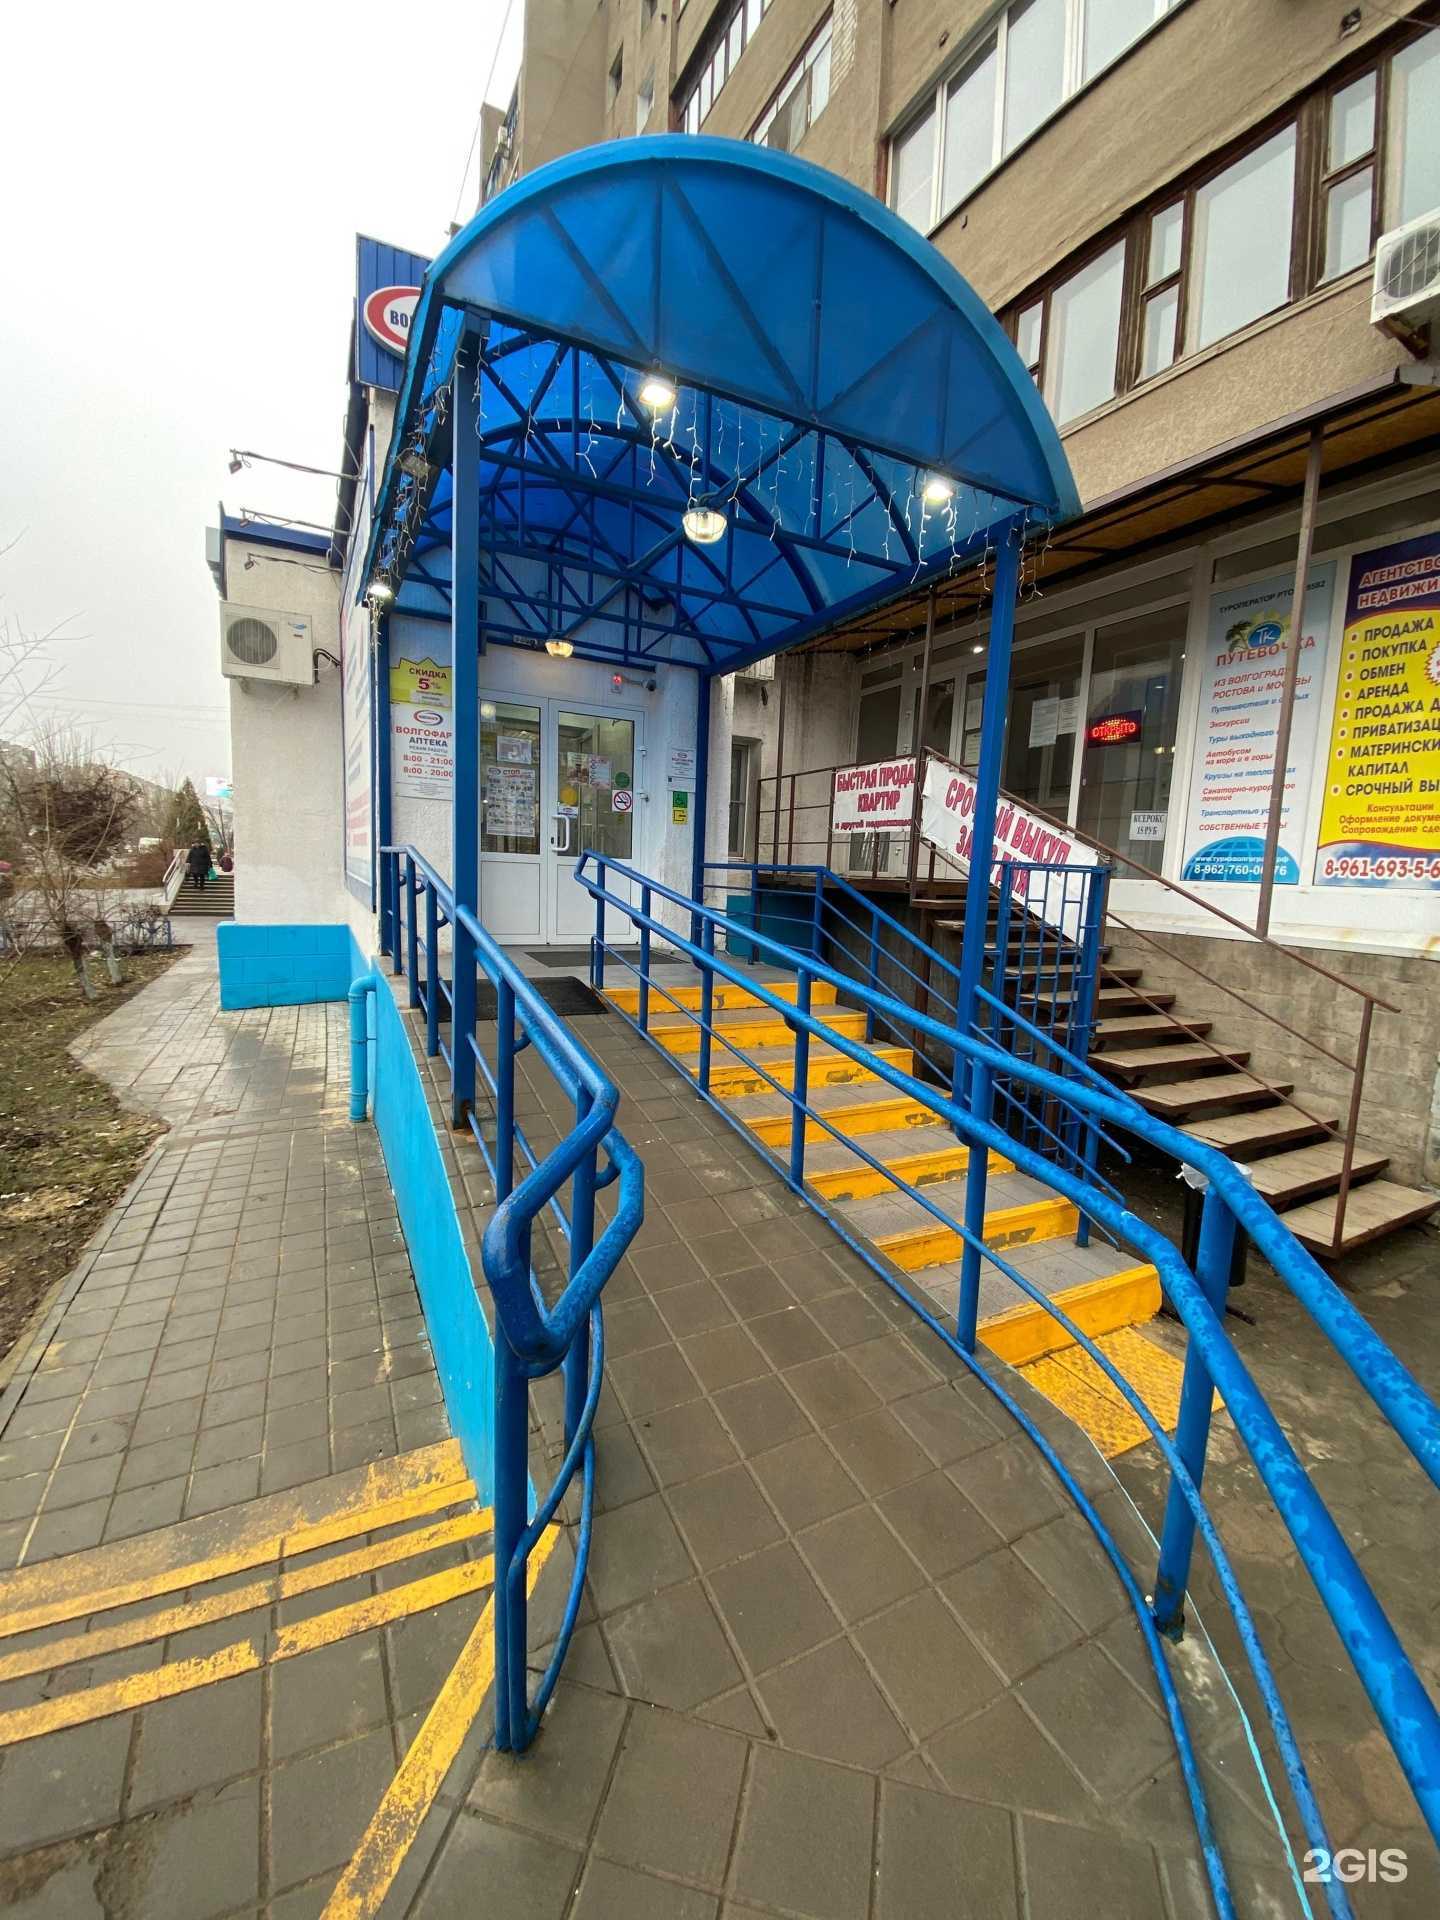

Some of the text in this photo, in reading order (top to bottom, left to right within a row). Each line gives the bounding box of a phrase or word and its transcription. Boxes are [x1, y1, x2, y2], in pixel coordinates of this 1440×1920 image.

[1359, 578, 1439, 608] НЕДВИЖИ
[1219, 593, 1276, 613] ТУРОПЕРАТОР
[1364, 617, 1434, 641] ПРОДАЖА
[1362, 639, 1428, 661] ПОКУПКА
[409, 667, 447, 679] СКИДКА
[1214, 667, 1287, 689] ИЗ ВОЛГОГРАД
[1360, 663, 1405, 681] ОБМЕН
[1213, 686, 1256, 699] РОСТОВА
[1265, 675, 1311, 691] МОСВЫ
[1357, 682, 1409, 700] АРЕНДА
[1355, 700, 1424, 720] ПРОДАЖА
[1092, 721, 1137, 738] ОТКРЫТО
[1209, 718, 1250, 729] Экскурсии
[409, 736, 448, 748] АПТЕКА
[1208, 735, 1228, 744] Туры
[1206, 748, 1251, 758] Автобусом
[1350, 739, 1440, 758] МАТЕРИНСКИ
[1216, 757, 1235, 766] море
[1251, 754, 1273, 763] горы
[1204, 773, 1232, 782] Круизы
[1348, 761, 1409, 778] КАПИТАЛ
[836, 769, 878, 793] БЫСТРАЯ
[1346, 778, 1440, 796] СРОЧНЫЙ ВЫ
[858, 790, 900, 813] КВАРТИР
[1202, 794, 1232, 802] лечение
[1201, 808, 1259, 817] Транспортные
[1367, 803, 1434, 814] Консультации
[841, 819, 864, 831] другой
[1133, 814, 1165, 824] КСЕРОКС
[1199, 822, 1260, 831] СОБСТВЕННЫЕ
[1339, 814, 1400, 826] Оформление
[1341, 825, 1418, 836] Сопровождение
[1011, 816, 1072, 877] ВЫКУП
